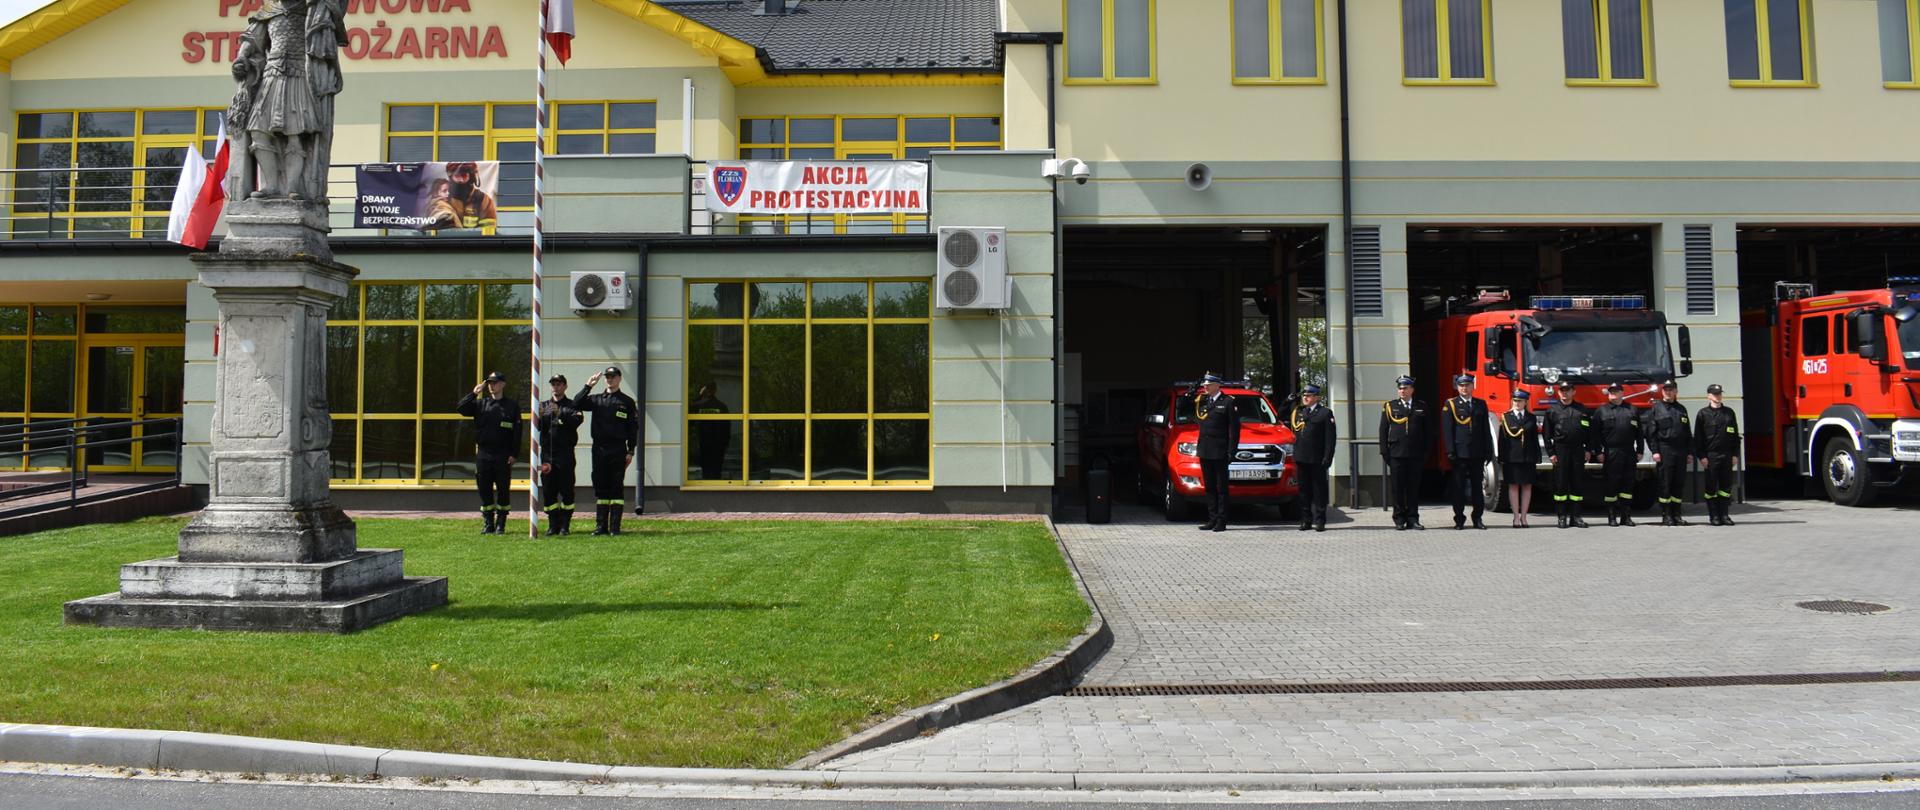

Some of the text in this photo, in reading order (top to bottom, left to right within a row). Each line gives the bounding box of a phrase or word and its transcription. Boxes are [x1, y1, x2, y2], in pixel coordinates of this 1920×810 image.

[343, 20, 508, 60] OŻARNA
[802, 166, 868, 185] AKCJA
[362, 195, 395, 204] DBAMY
[750, 190, 920, 209] PROTESTACYJNA
[362, 205, 400, 214] O TWOJE
[363, 215, 436, 225] BEZPIECZEŃSTWO
